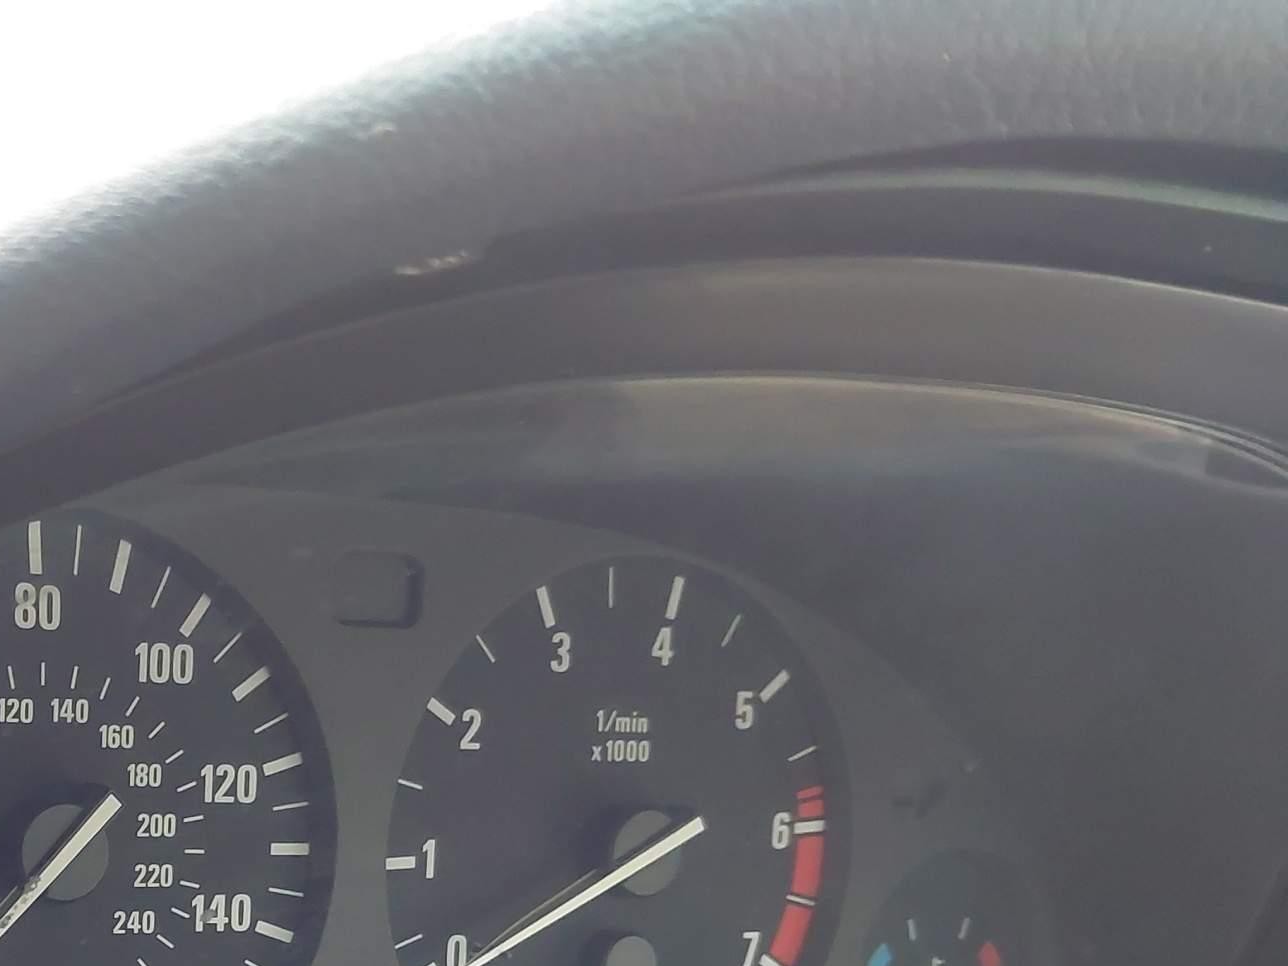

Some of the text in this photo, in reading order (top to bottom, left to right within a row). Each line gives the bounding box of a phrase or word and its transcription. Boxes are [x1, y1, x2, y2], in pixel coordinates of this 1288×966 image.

[14, 583, 61, 630] 80
[135, 642, 194, 684] 100
[550, 632, 570, 673] 3
[651, 626, 673, 666] 4
[50, 698, 89, 724] 140
[460, 709, 481, 750] 2
[595, 709, 648, 733] 1/min
[734, 690, 754, 730] 5
[99, 725, 135, 749] 160
[591, 740, 650, 763] x1000
[127, 763, 162, 788] 180
[200, 763, 257, 804] 120
[137, 813, 176, 838] 200
[771, 811, 790, 850] 6
[134, 864, 173, 888] 220
[421, 838, 435, 879] 1
[113, 910, 155, 936] 240
[191, 893, 252, 933] 140
